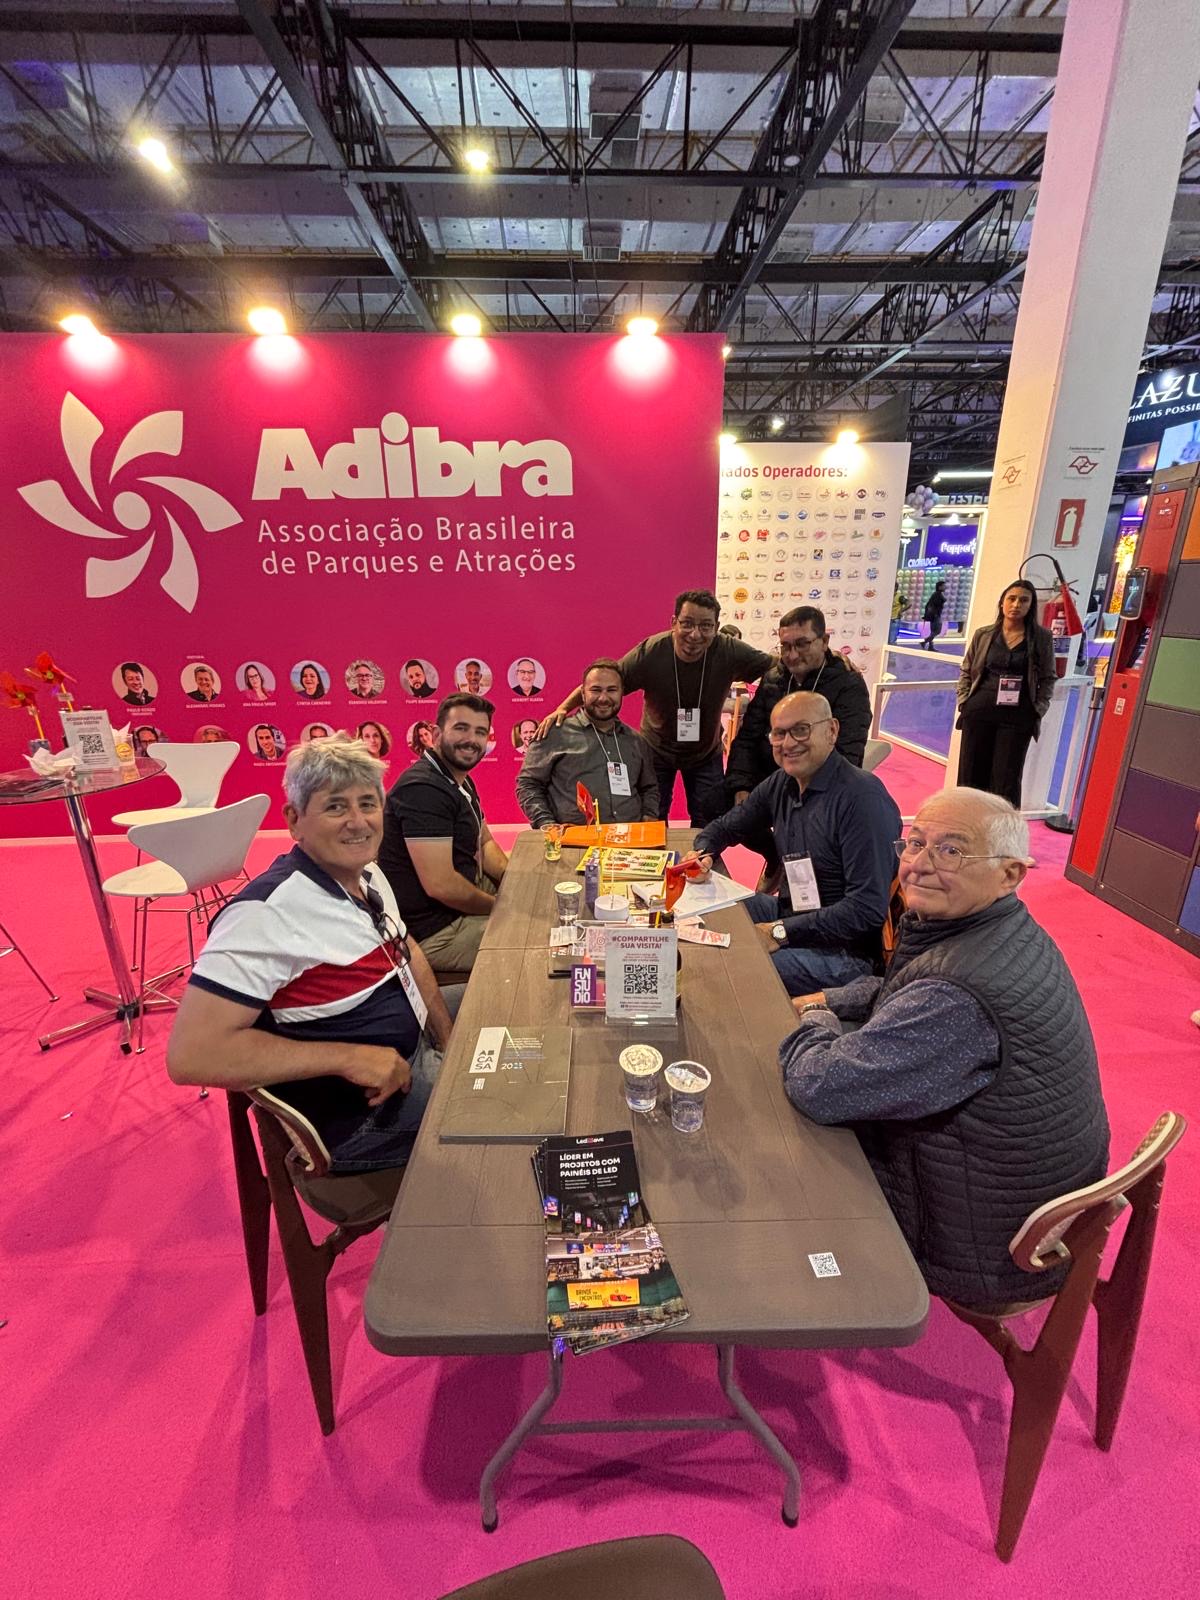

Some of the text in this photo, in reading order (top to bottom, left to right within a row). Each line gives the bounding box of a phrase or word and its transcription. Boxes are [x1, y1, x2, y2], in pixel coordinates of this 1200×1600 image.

[252, 412, 574, 500] Adibra
[762, 464, 848, 480] Operadores:
[258, 515, 575, 548] Associação Brasileira
[261, 548, 576, 581] de Parques e Atrações
[612, 935, 669, 943] #COMPARTILHE
[559, 1152, 594, 1161] LÍDER EM
[559, 1157, 621, 1169] PROJETOS COM
[560, 1169, 591, 1178] PAINÉIS
[603, 1166, 618, 1174] LED
